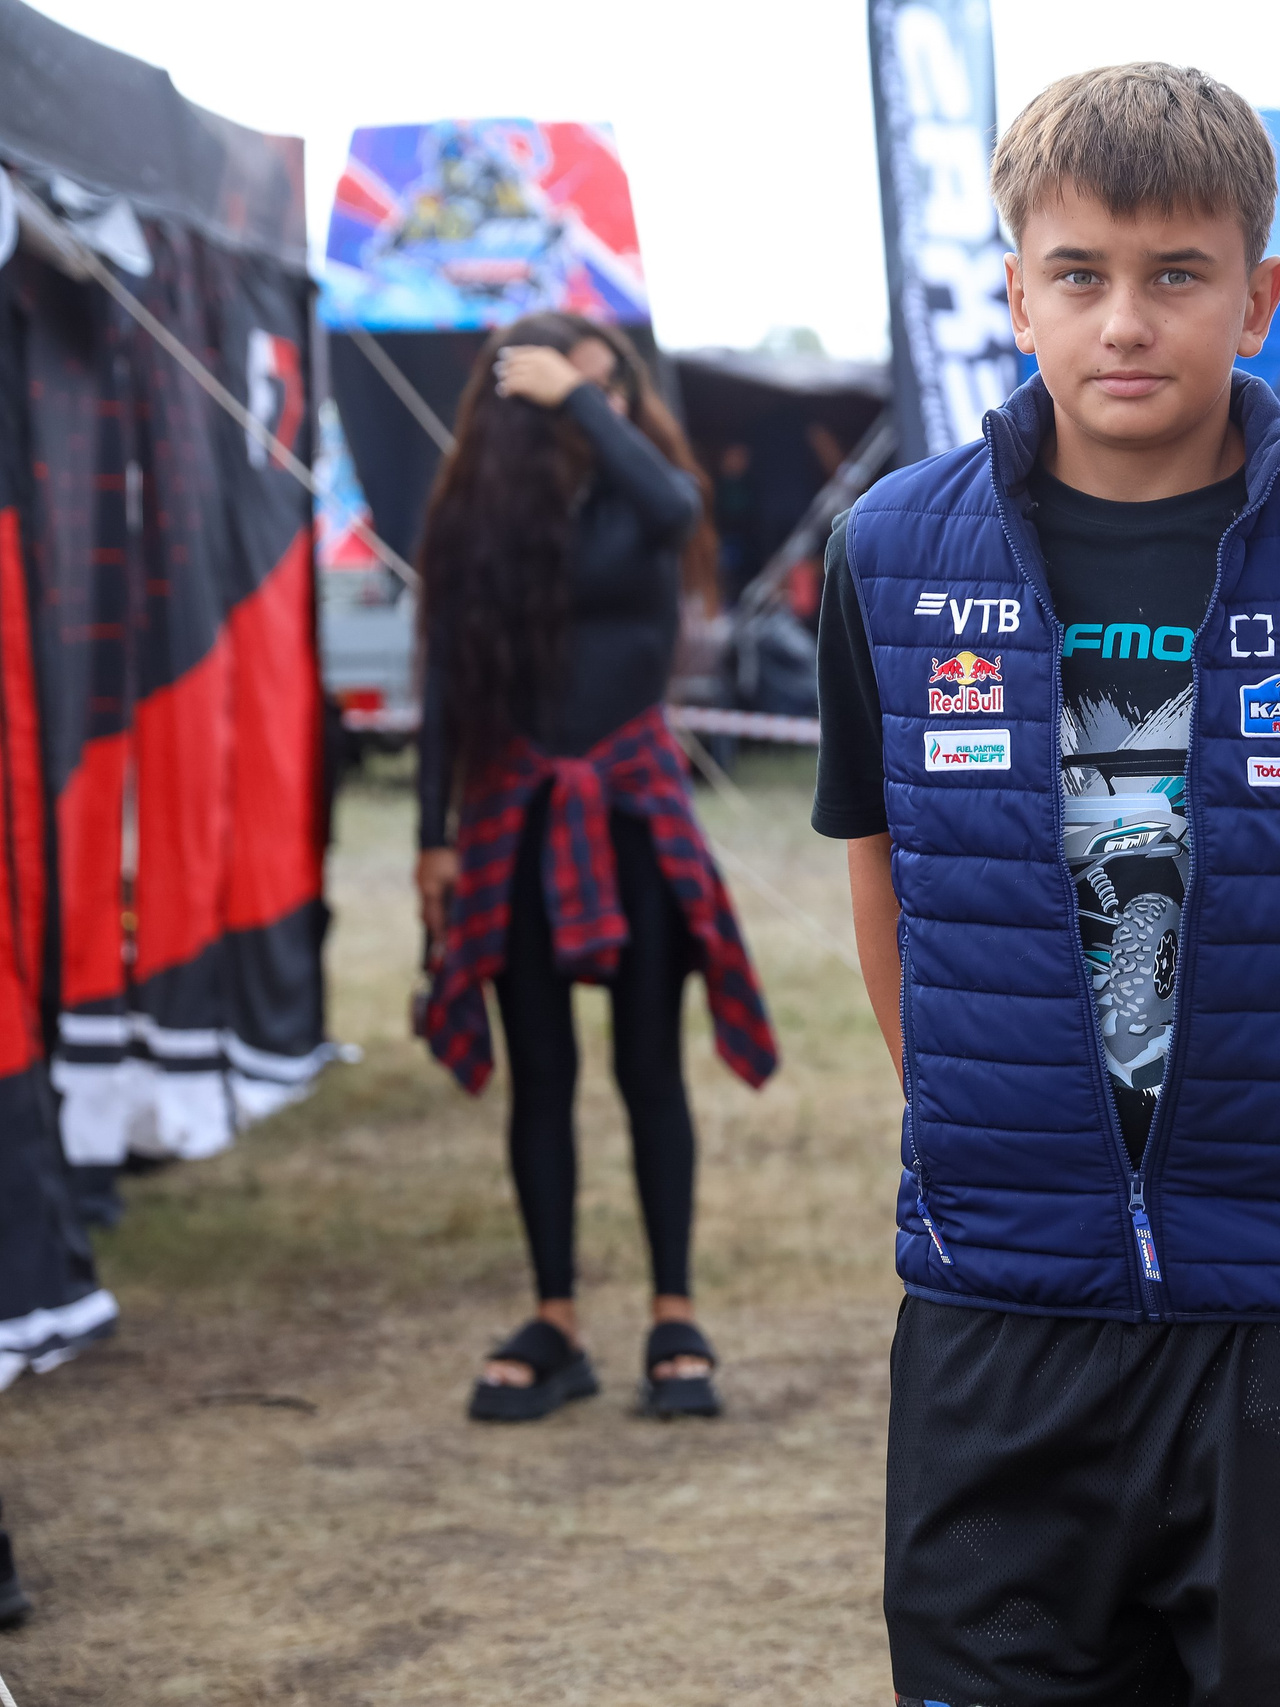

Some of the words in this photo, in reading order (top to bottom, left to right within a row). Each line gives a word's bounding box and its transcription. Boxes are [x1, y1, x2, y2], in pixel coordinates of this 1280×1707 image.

[949, 598, 1021, 635] VTB
[1060, 622, 1196, 663] FMO
[928, 685, 966, 714] Red
[966, 685, 1004, 713] Bull
[942, 752, 1005, 764] TATNEFT
[956, 745, 972, 754] FUEL
[973, 744, 1005, 753] PARTNER
